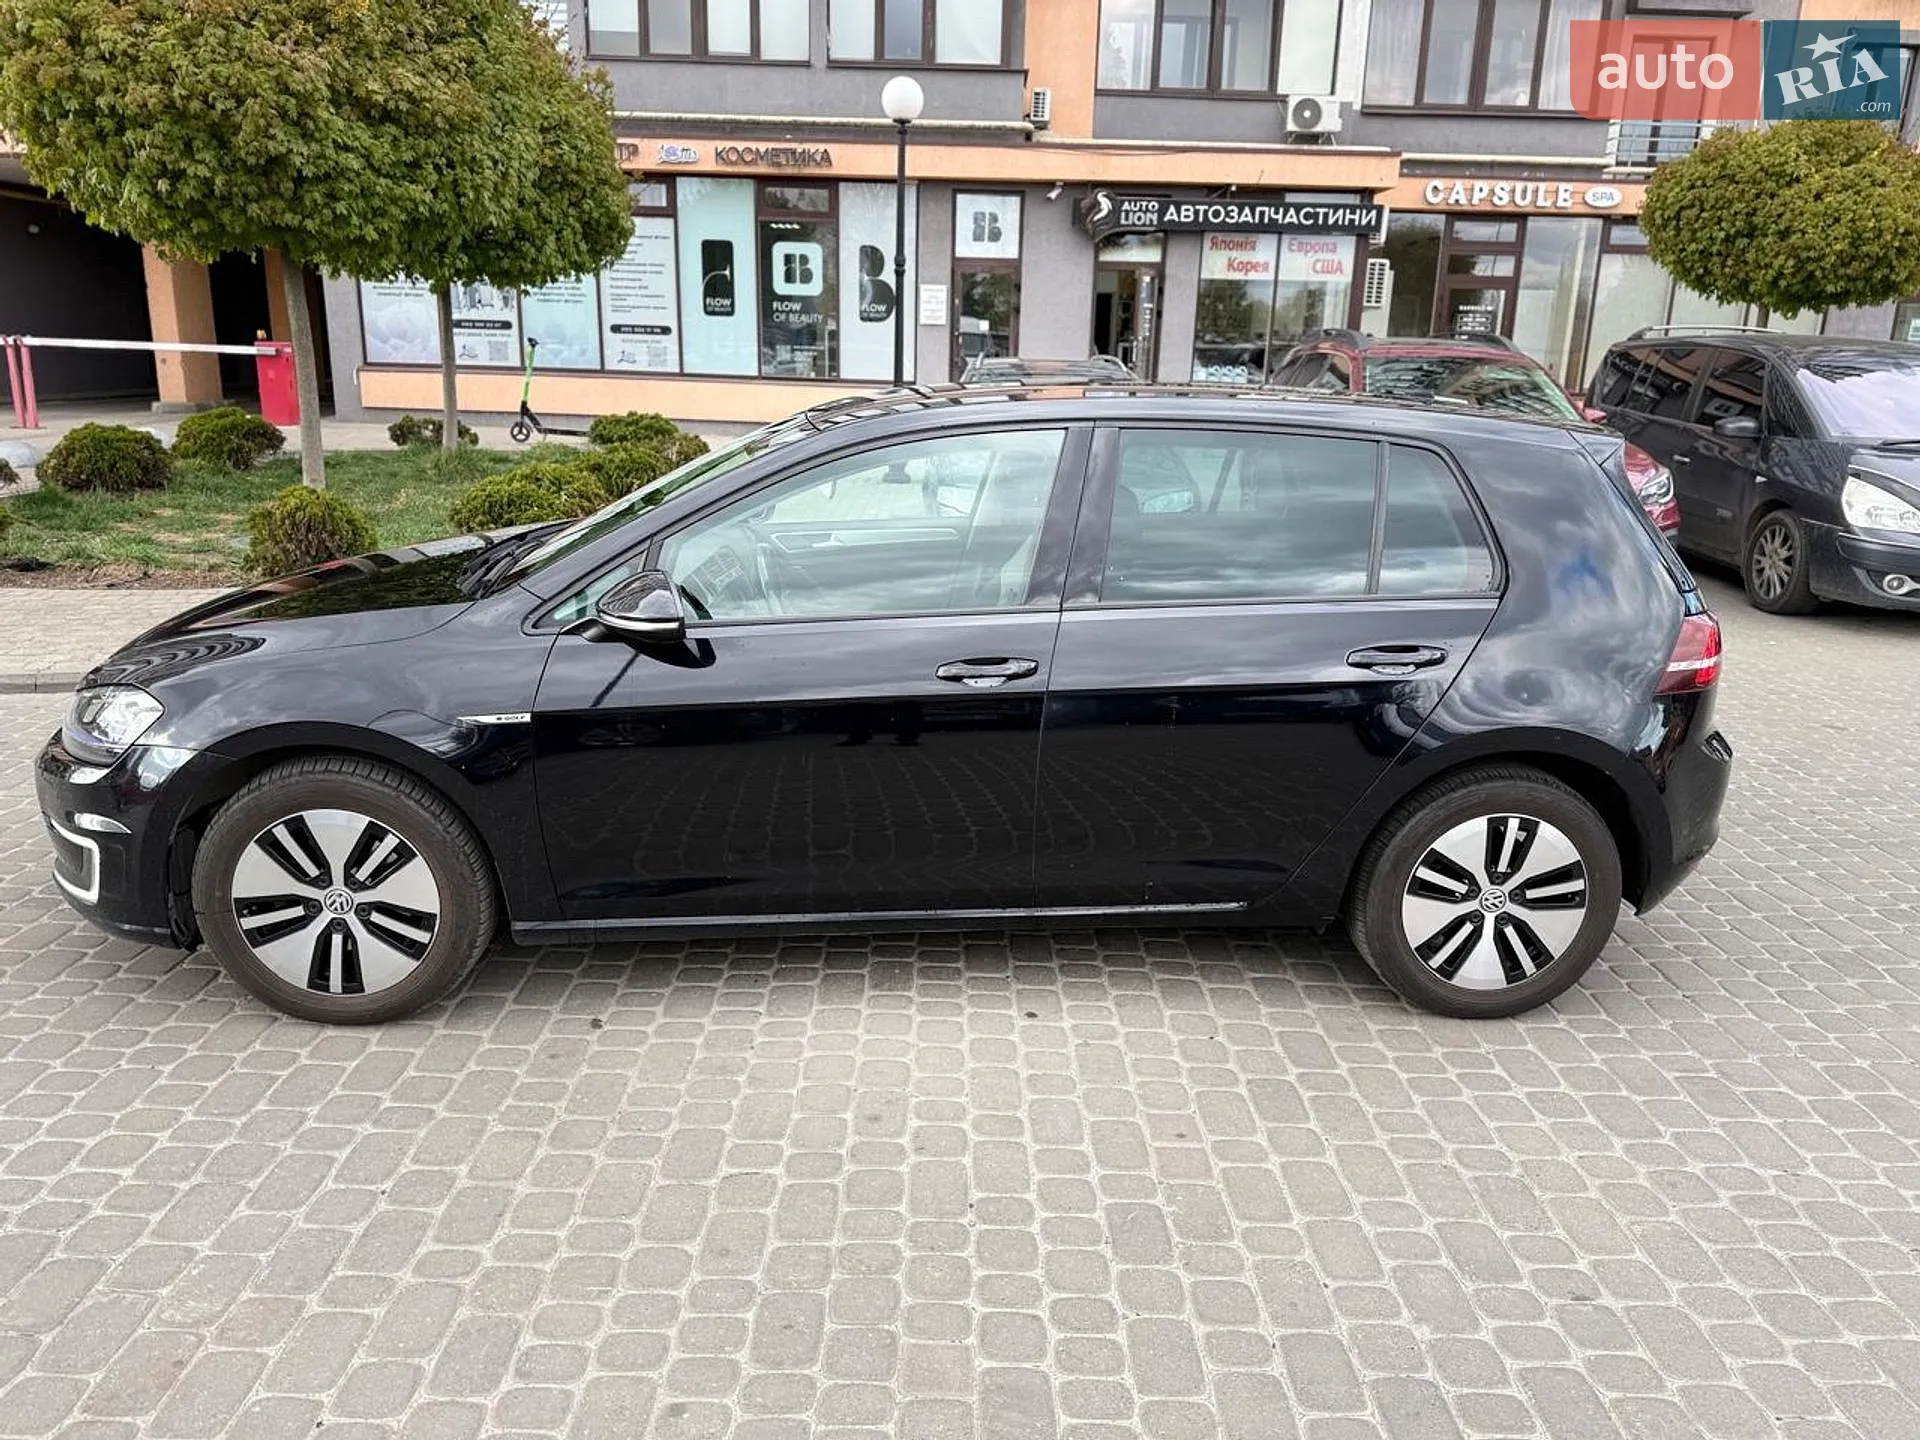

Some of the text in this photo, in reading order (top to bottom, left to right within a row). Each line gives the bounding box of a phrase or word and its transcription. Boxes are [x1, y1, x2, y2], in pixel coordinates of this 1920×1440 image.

[714, 146, 833, 168] КОСМЕТИКА
[1425, 179, 1574, 208] CAPSULE
[1591, 193, 1616, 203] SPA
[1121, 201, 1160, 212] AUTO
[1120, 211, 1158, 225] LION
[1163, 204, 1378, 227] АВТОЗАПЧАСТИНИ
[1209, 235, 1257, 254] Японія
[1226, 257, 1270, 276] Корея
[1312, 258, 1344, 275] США
[705, 297, 732, 306] FLOW
[772, 302, 802, 312] FLOW
[772, 313, 823, 323] OF BEAUTY
